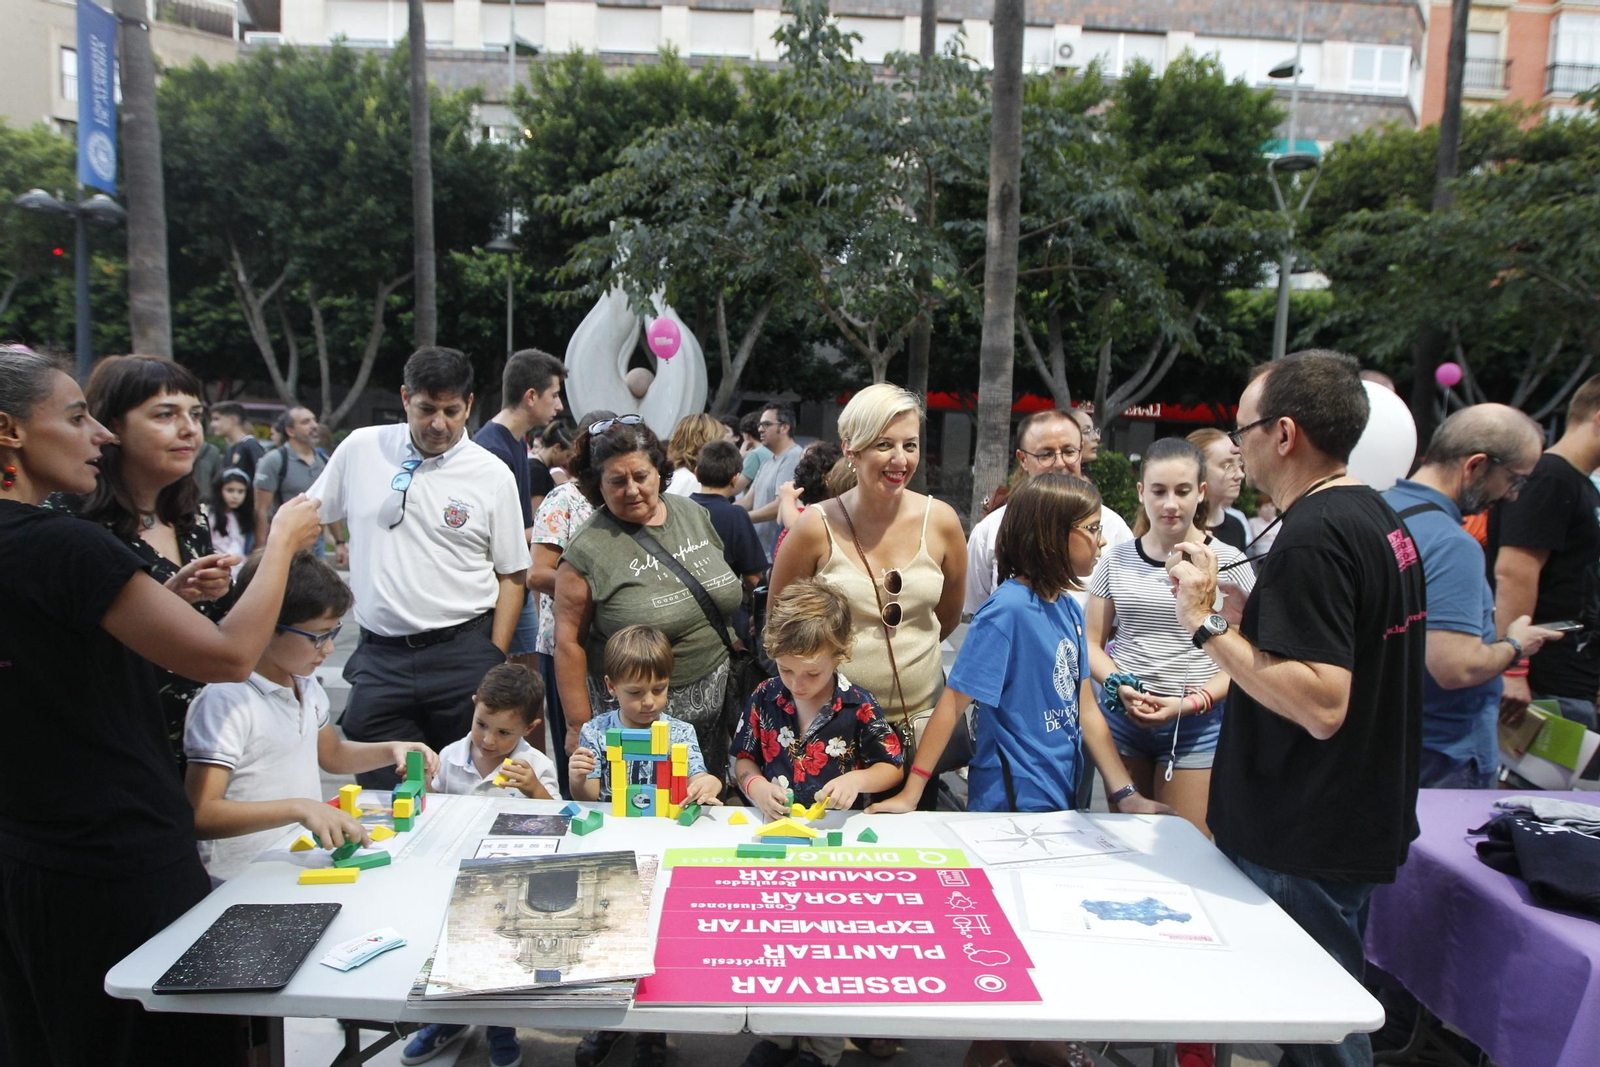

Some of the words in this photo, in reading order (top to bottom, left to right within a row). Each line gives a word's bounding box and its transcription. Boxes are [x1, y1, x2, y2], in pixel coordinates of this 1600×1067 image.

[629, 554, 659, 577] Self
[672, 538, 709, 561] onfidence
[1044, 700, 1079, 721] UNIVER
[1045, 718, 1061, 733] DE
[714, 879, 797, 887] Resultados
[739, 870, 917, 882] COMUNICAR
[760, 892, 924, 905] ELABORAR
[690, 902, 797, 911] Conclusiones
[697, 919, 935, 934] EXPERIMENTAR
[762, 944, 946, 960] PLANTEAR
[702, 957, 787, 967] Hipótesis
[731, 976, 946, 994] OBSERVAR
